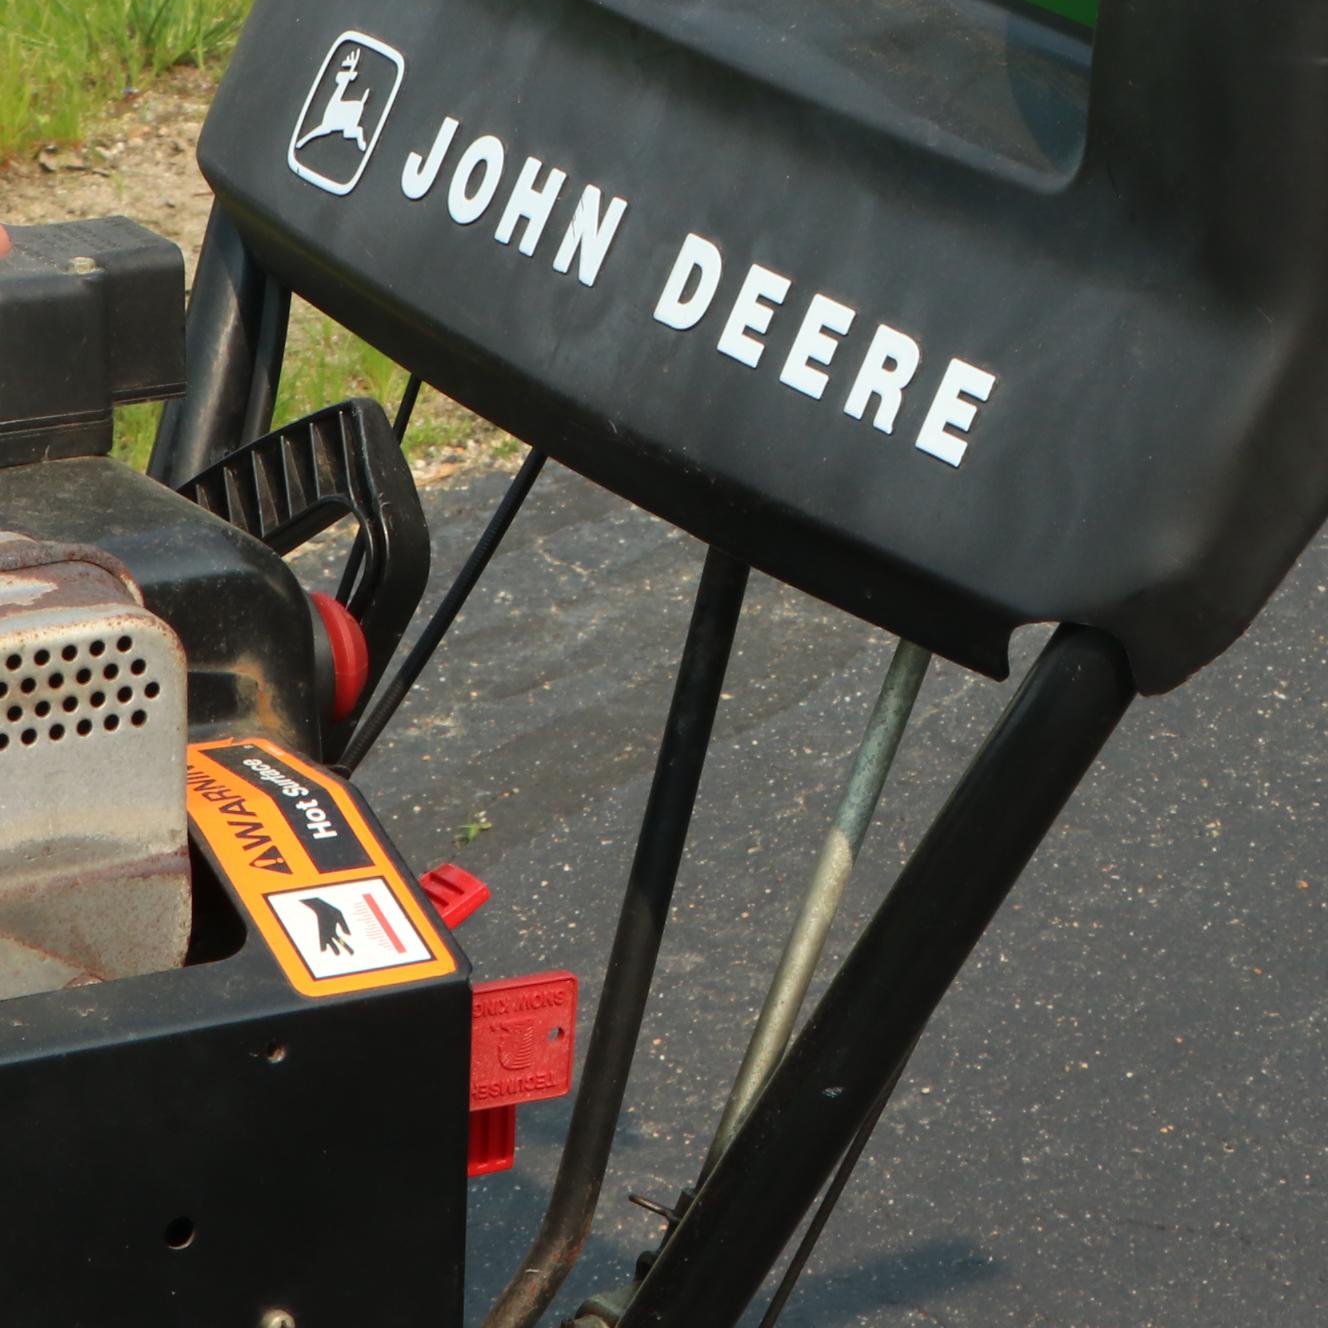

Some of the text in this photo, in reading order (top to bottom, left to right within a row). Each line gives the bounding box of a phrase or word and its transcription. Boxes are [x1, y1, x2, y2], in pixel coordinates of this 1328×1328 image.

[400, 116, 996, 468] JOHN DEERE
[242, 758, 338, 840] Hot Surface
[514, 990, 564, 1012] SNOW
